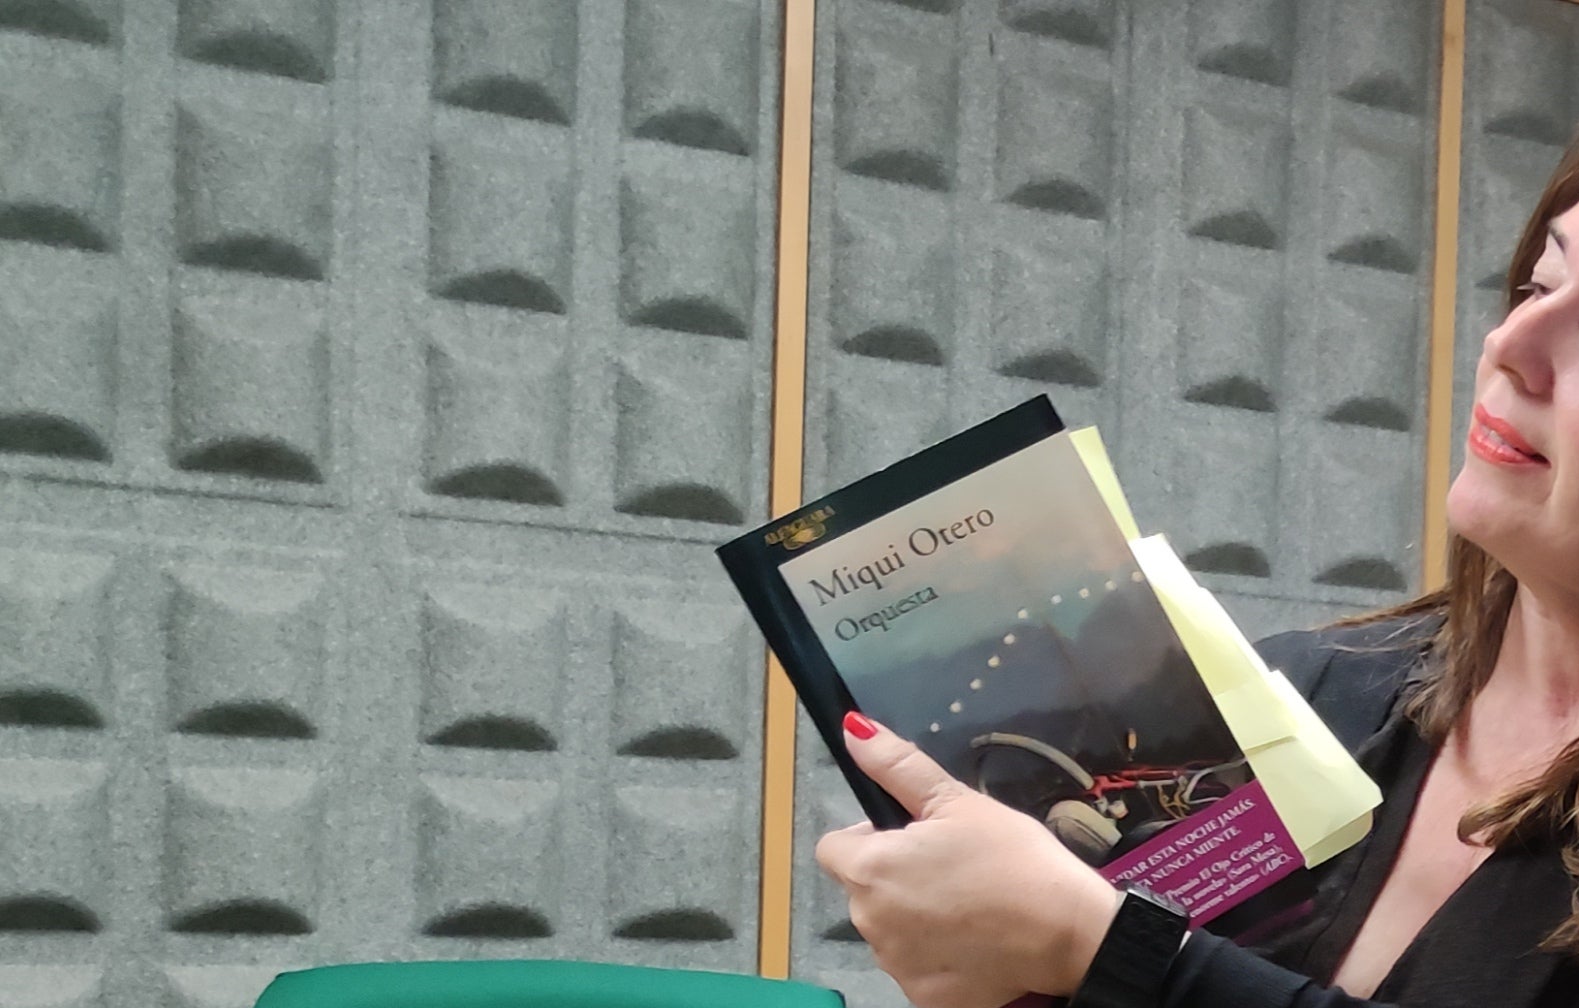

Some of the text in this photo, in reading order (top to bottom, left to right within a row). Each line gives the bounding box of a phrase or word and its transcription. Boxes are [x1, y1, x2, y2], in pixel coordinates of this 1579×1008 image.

[809, 508, 994, 607] Miqui Otero
[834, 587, 939, 641] Orquesta
[1148, 842, 1177, 867] ESTA
[1175, 820, 1218, 848] NOCHE
[1151, 852, 1195, 881] NUNCA
